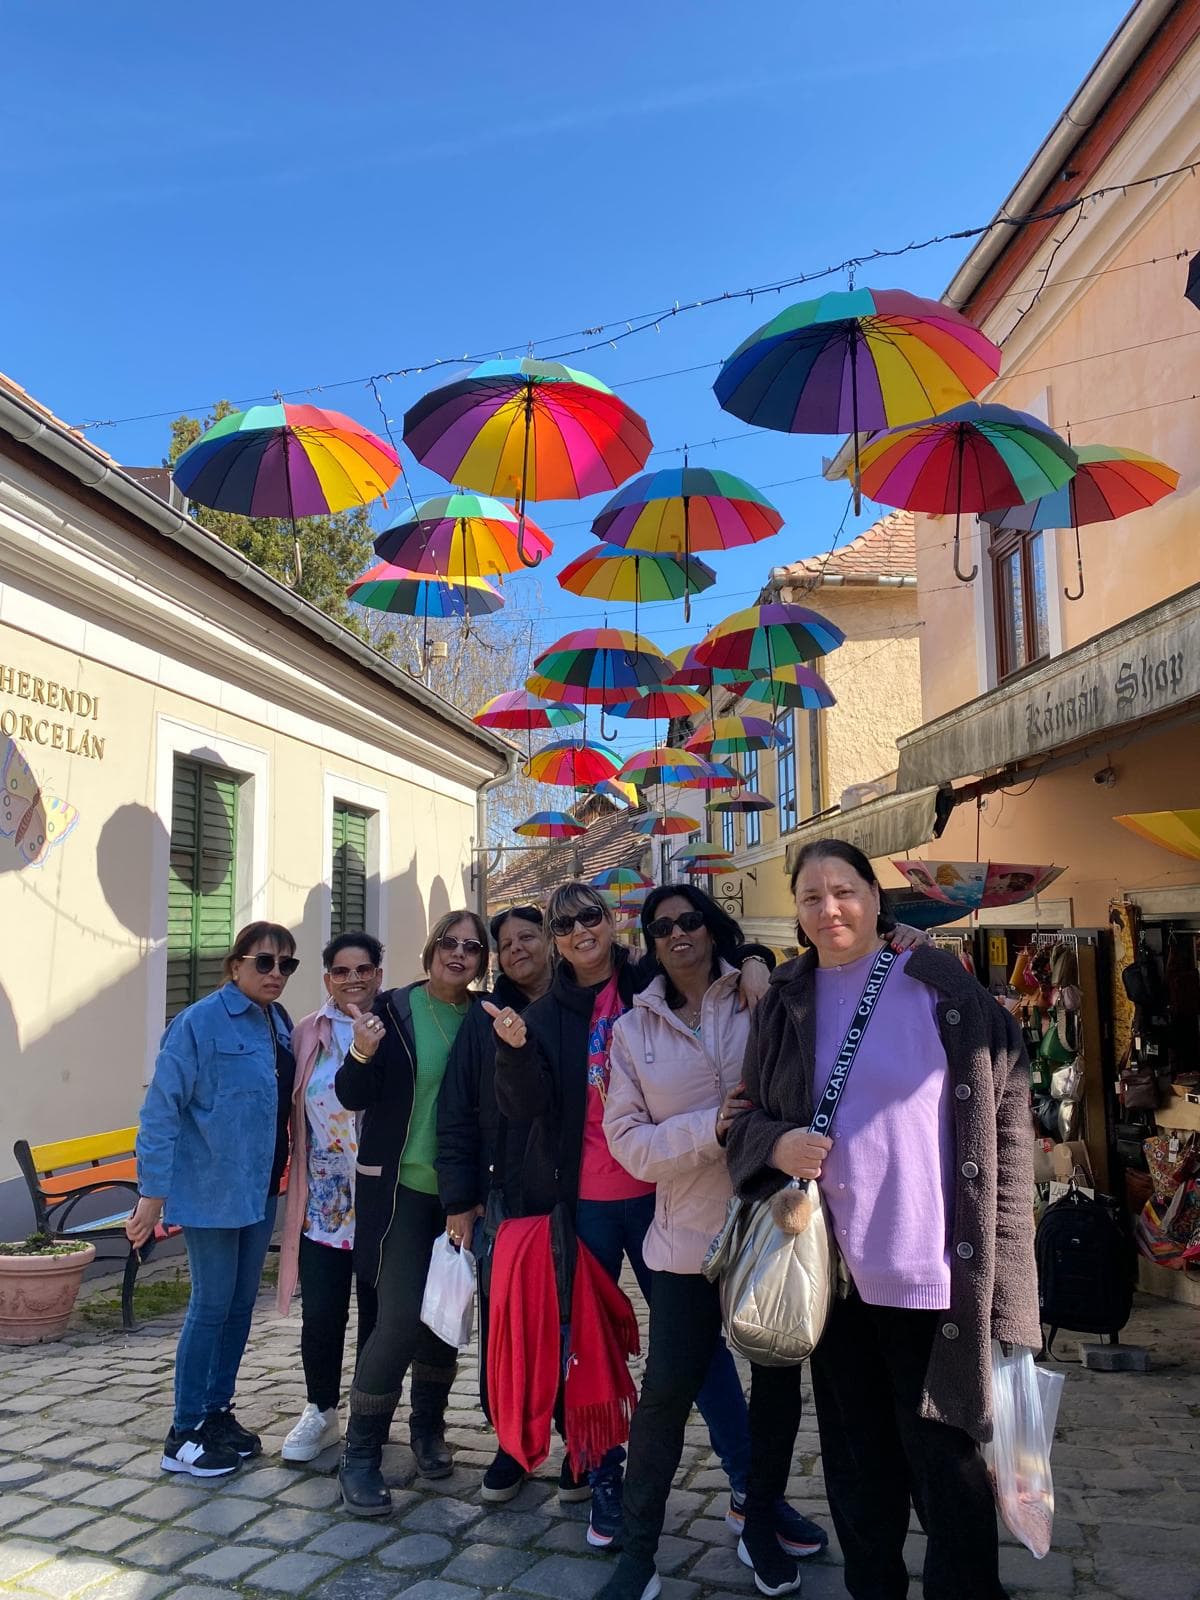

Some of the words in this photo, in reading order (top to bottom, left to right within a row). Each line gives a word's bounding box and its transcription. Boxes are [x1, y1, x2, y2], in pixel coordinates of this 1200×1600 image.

[0, 664, 100, 721] HERENDI
[1115, 651, 1184, 712] Shop
[0, 709, 106, 760] ORCELÁN
[825, 1028, 860, 1101] CARLITO
[859, 952, 893, 1016] CARLITO
